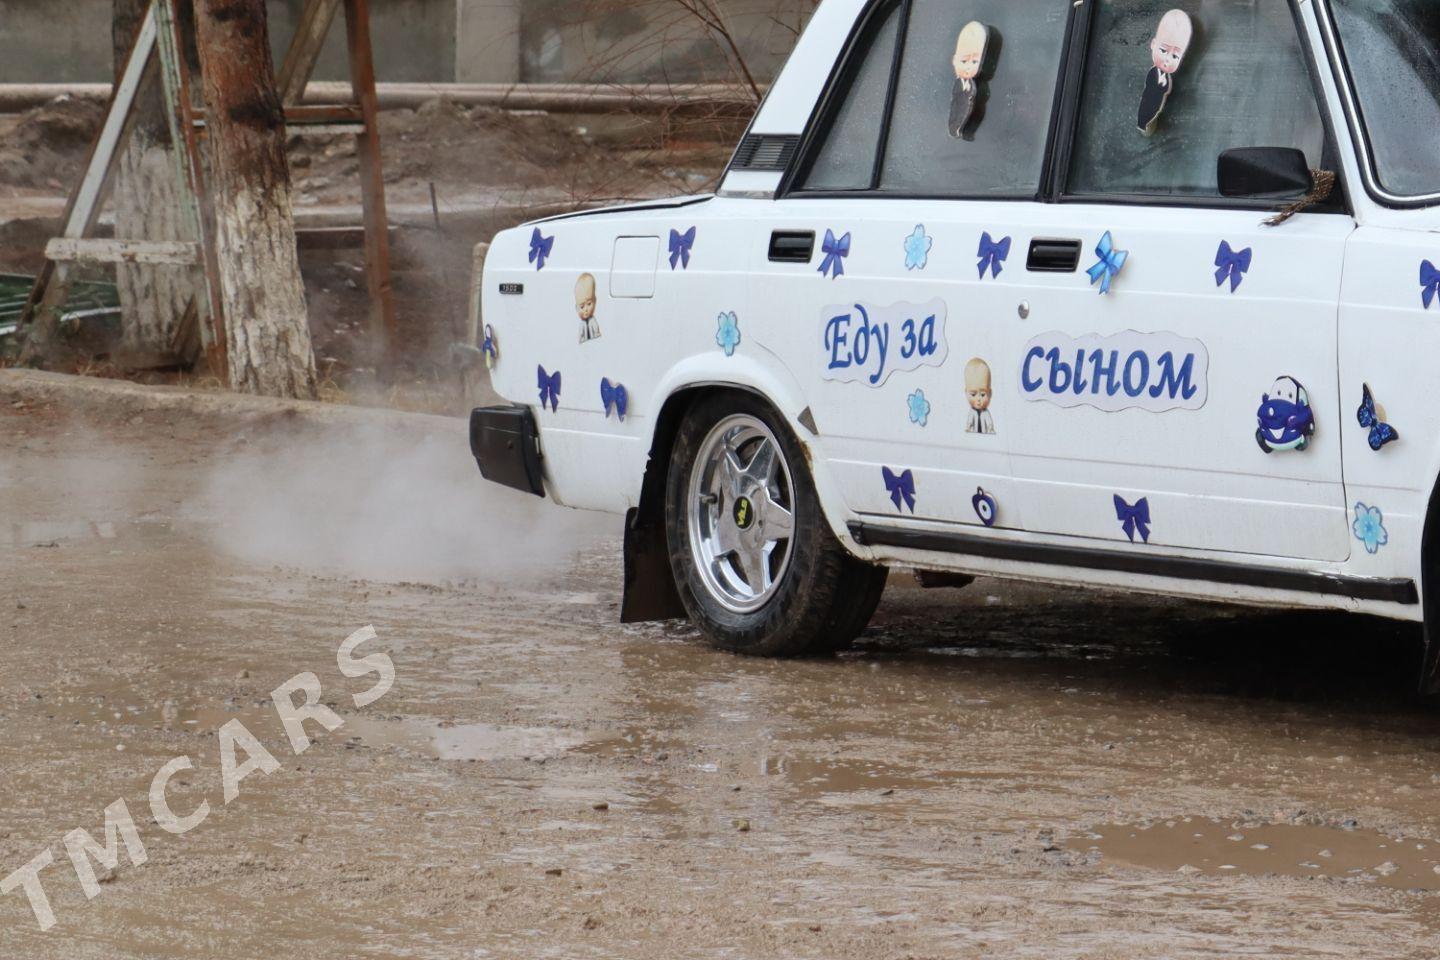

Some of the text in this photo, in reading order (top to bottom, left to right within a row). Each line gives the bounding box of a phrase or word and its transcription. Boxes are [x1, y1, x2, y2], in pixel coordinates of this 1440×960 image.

[824, 303, 938, 384] Еду за
[1021, 346, 1197, 400] сыном
